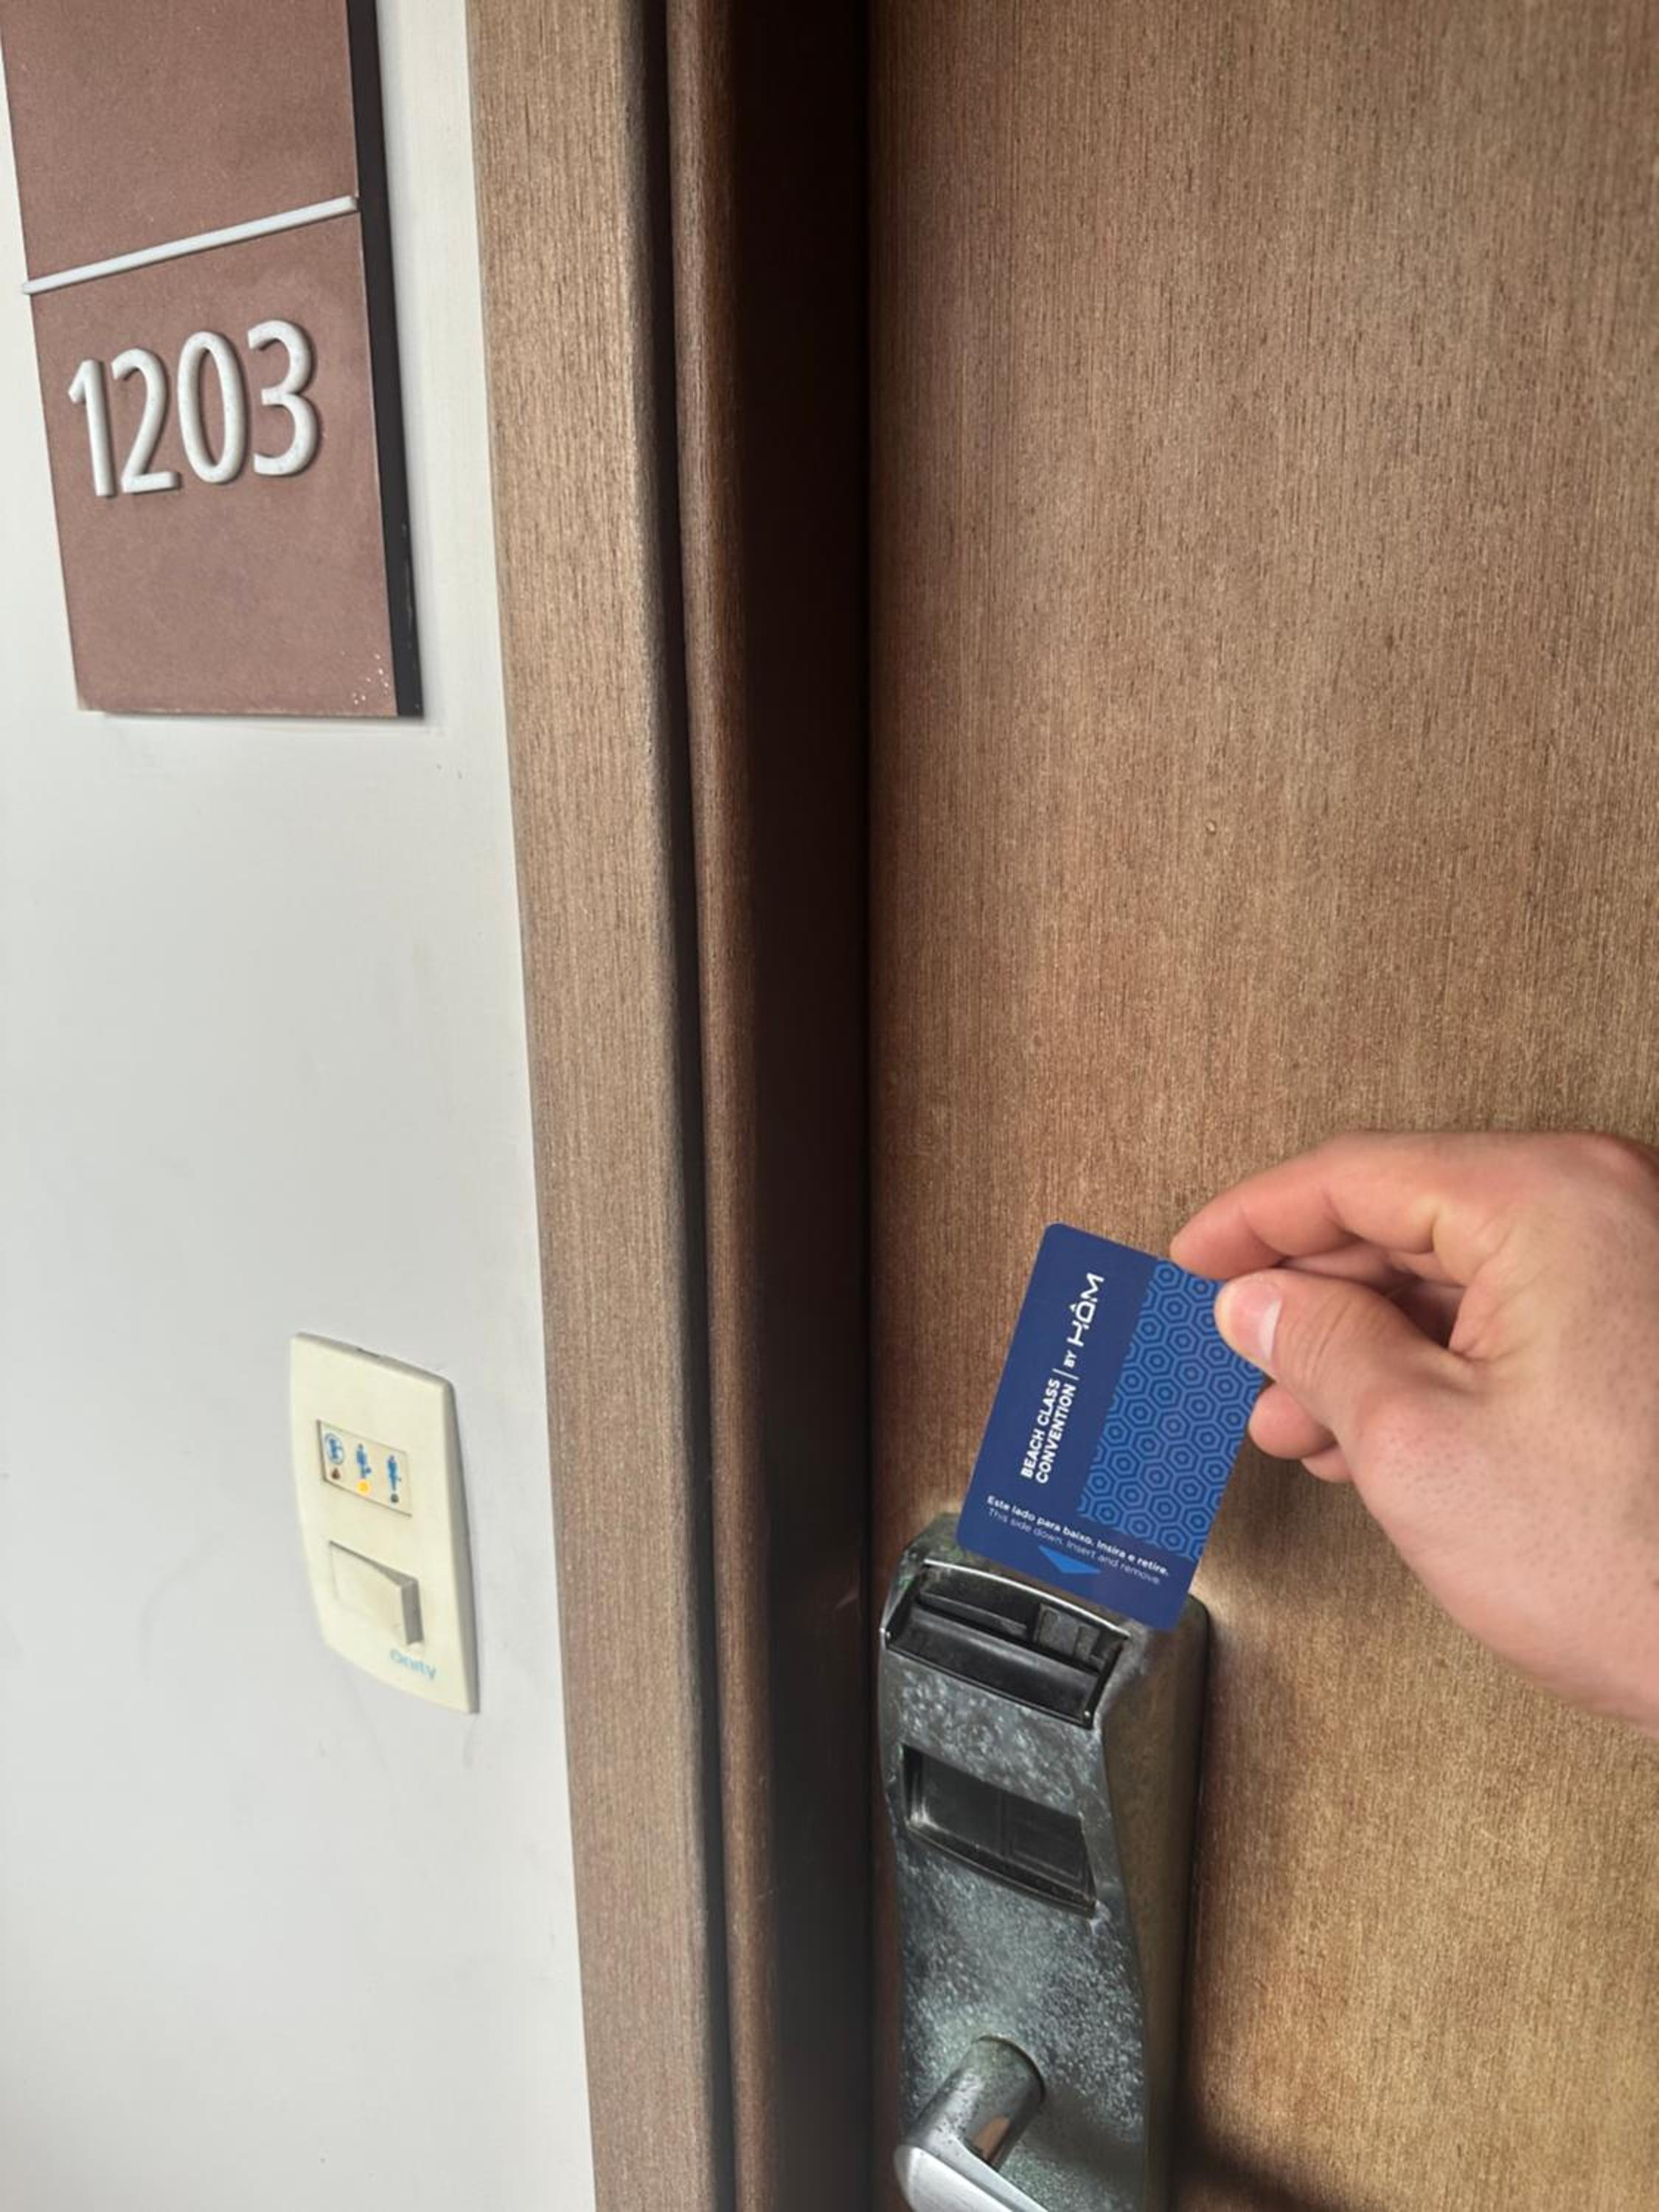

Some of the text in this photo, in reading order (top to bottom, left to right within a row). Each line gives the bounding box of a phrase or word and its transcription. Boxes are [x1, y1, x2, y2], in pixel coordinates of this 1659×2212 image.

[68, 319, 319, 496] 1203
[1063, 1273, 1105, 1368] BY HÔM
[1020, 1378, 1060, 1478] BEACH CLASS
[1035, 1383, 1077, 1484] CONVENTION
[987, 1495, 1010, 1511] Este
[1012, 1505, 1035, 1521] lado
[1036, 1517, 1061, 1532] para
[1096, 1539, 1126, 1559] Insira
[1127, 1554, 1135, 1562] e
[1136, 1557, 1169, 1576] retire.
[989, 1507, 1008, 1523] This
[1009, 1518, 1032, 1532] side
[1097, 1554, 1119, 1568] and
